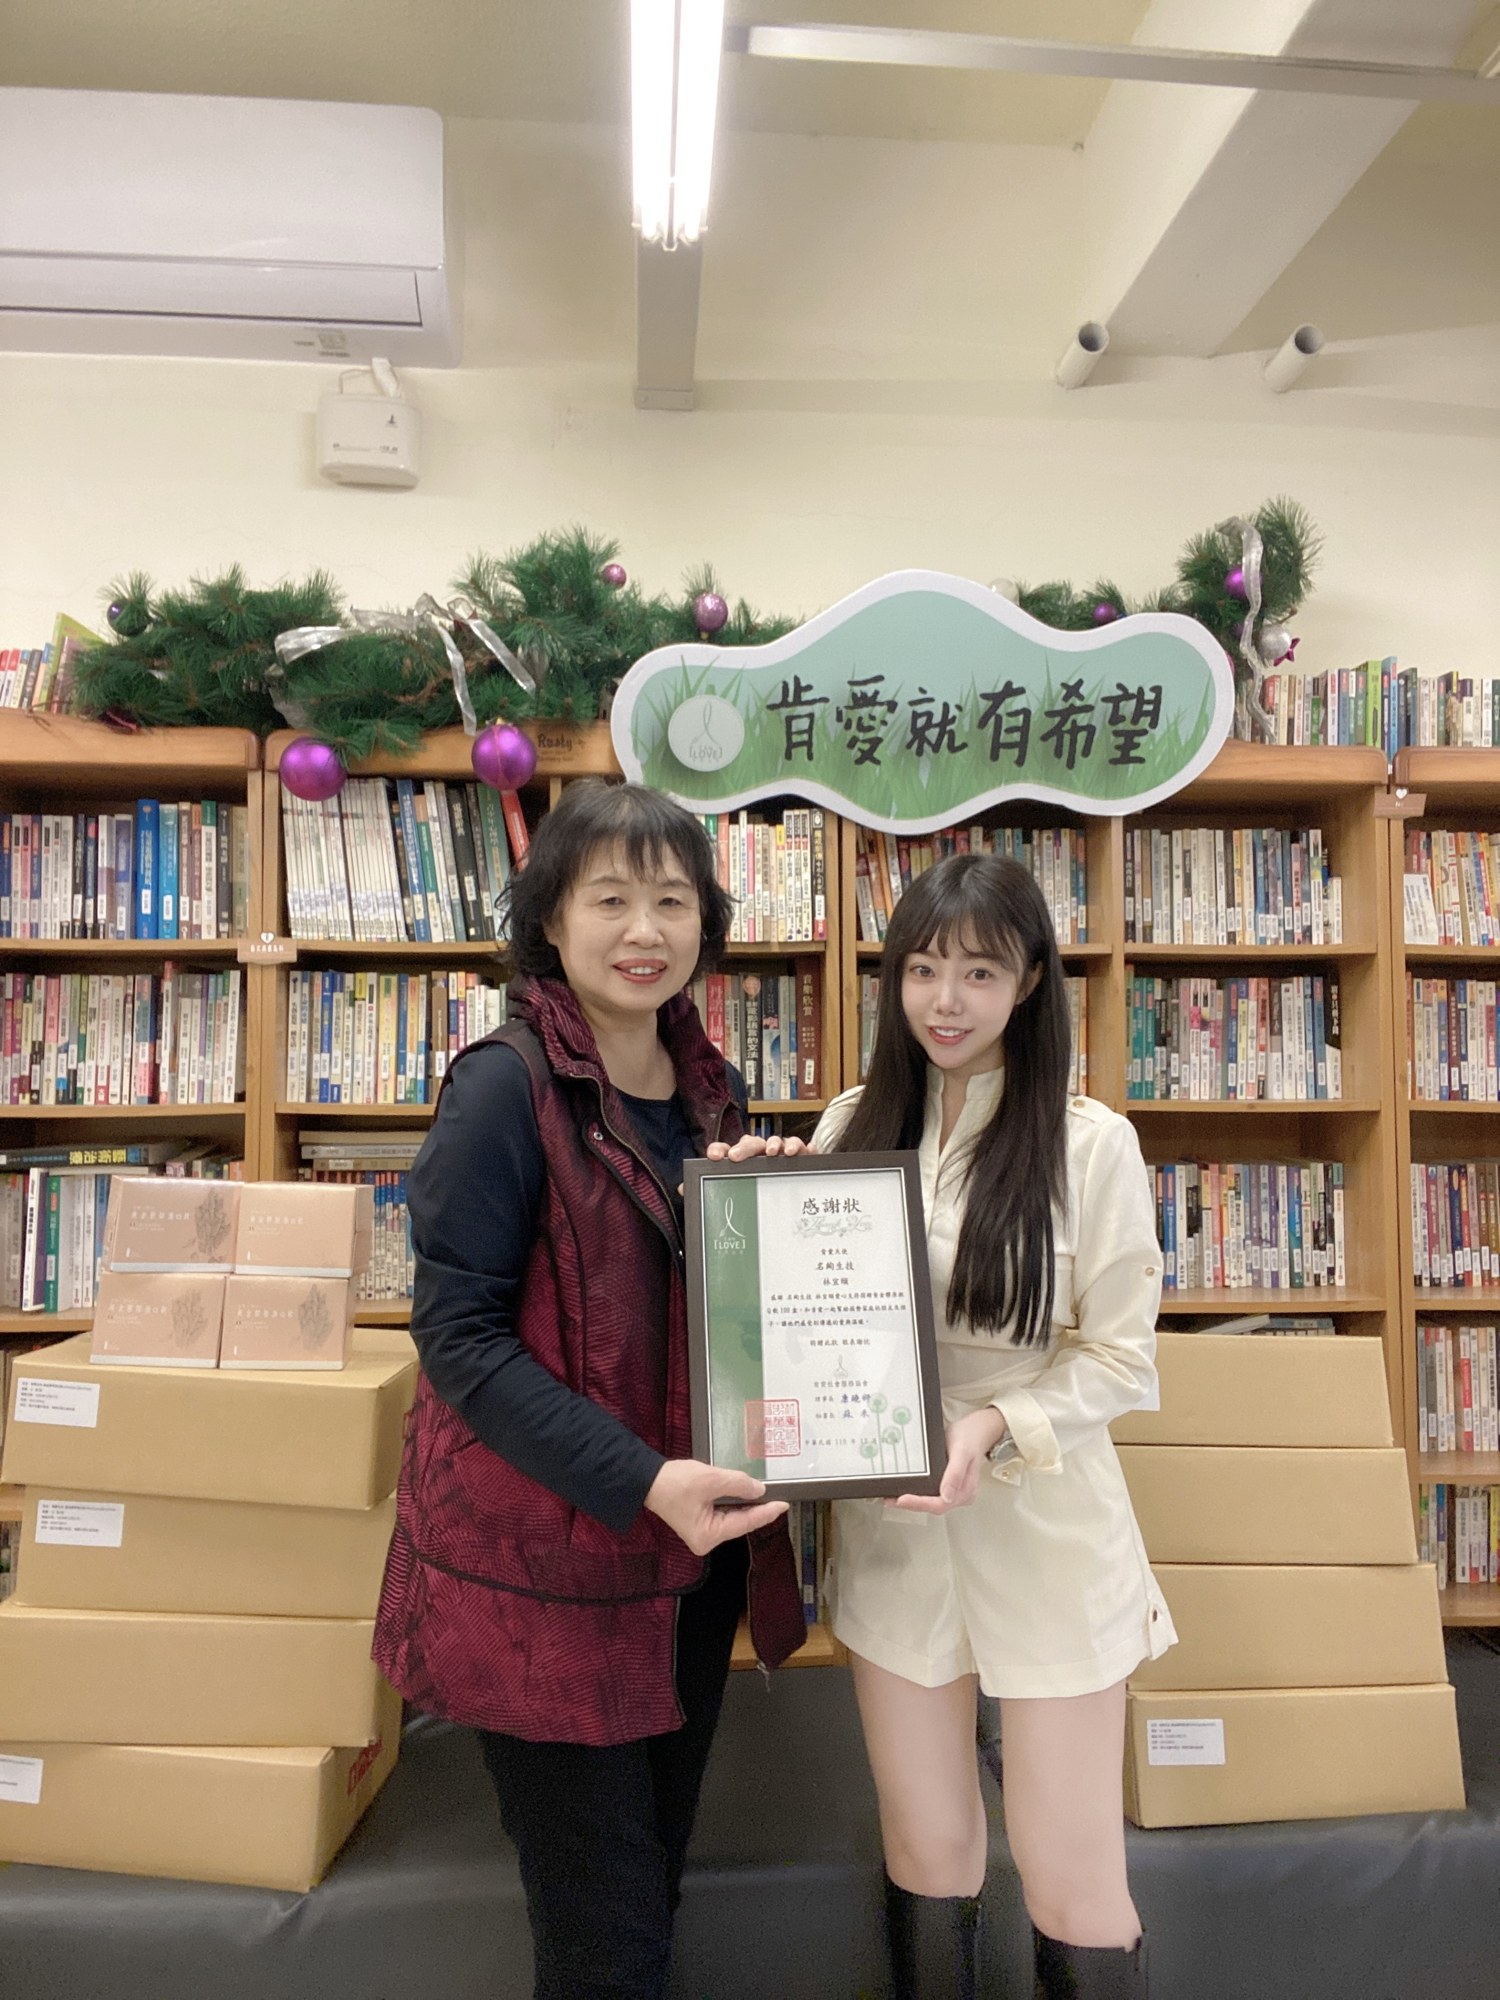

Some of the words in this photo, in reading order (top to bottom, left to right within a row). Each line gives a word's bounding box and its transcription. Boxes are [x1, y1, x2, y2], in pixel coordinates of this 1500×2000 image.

[766, 674, 1163, 769] 肯愛就有希望
[801, 1197, 862, 1216] 感謝狀
